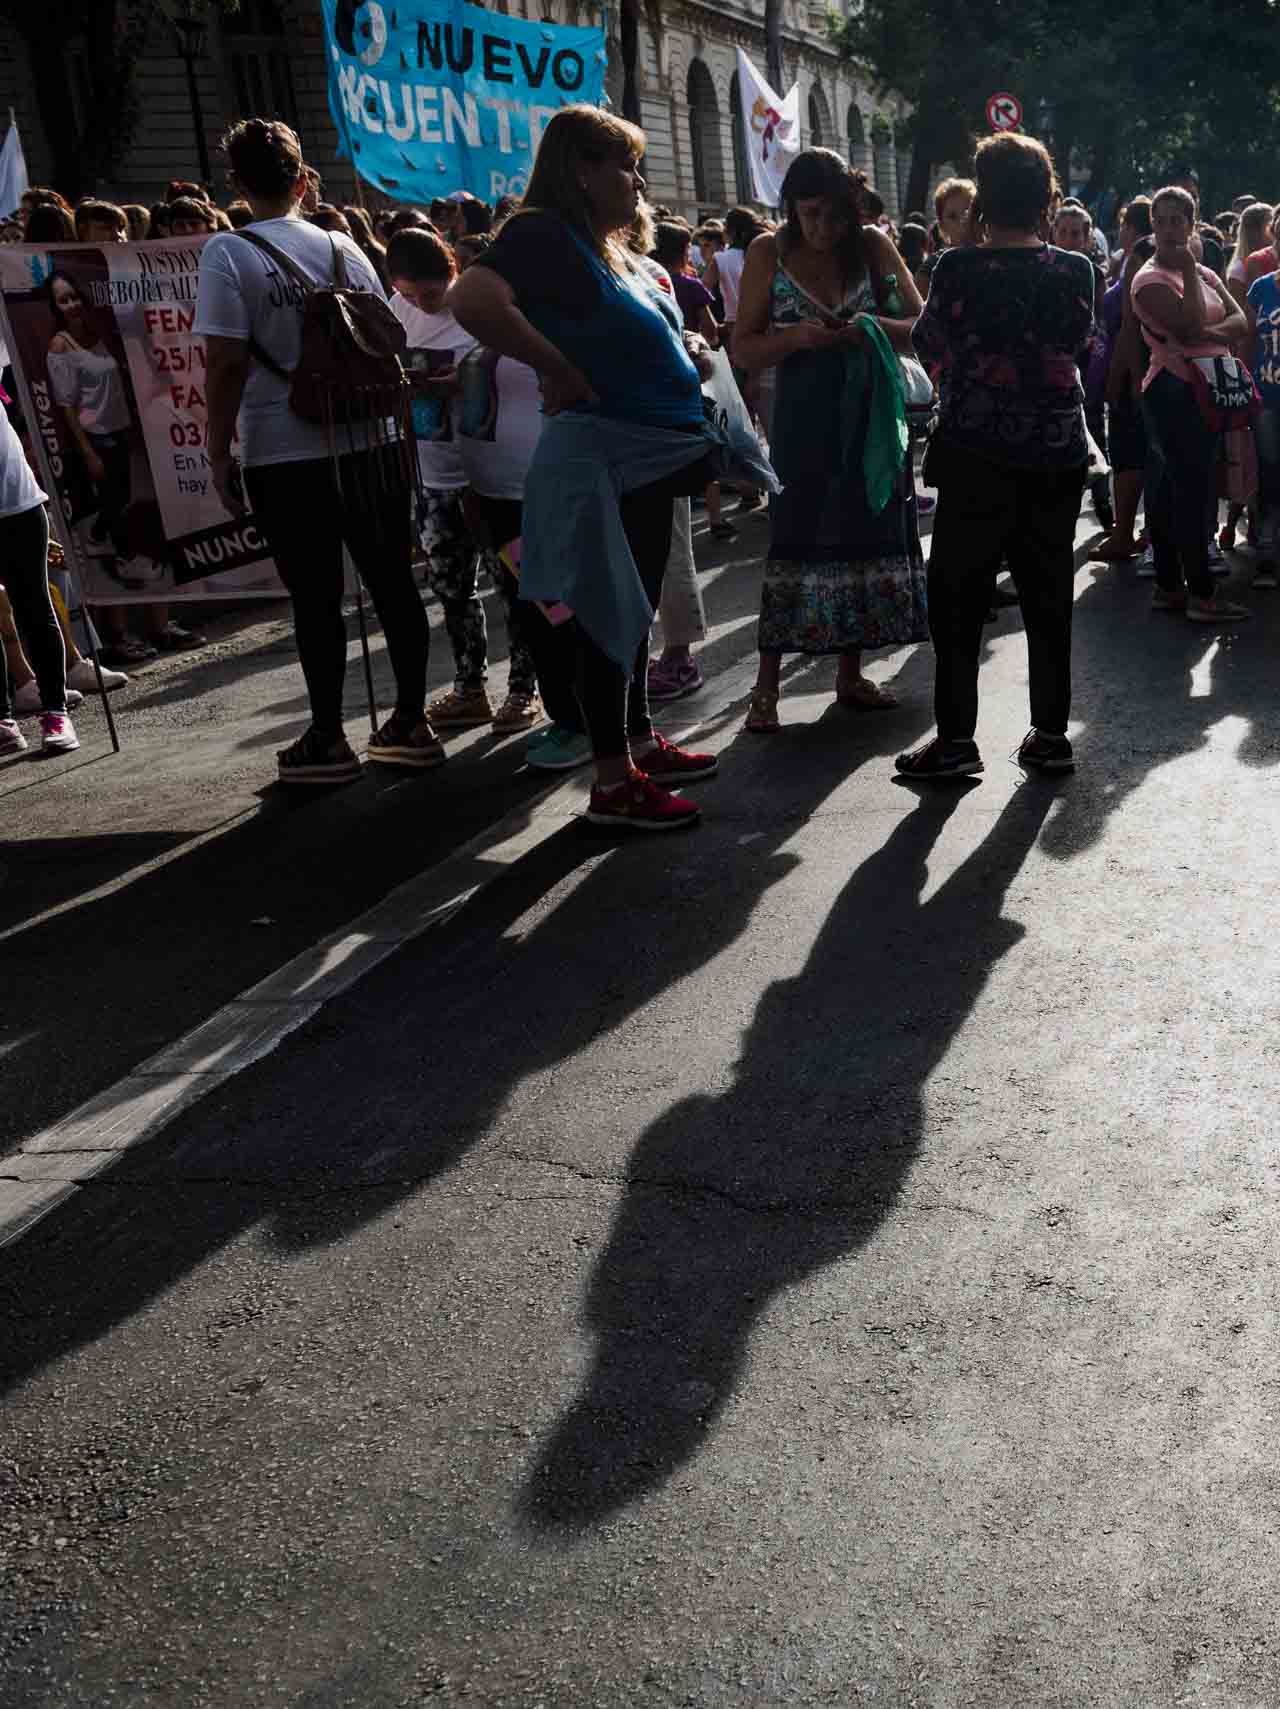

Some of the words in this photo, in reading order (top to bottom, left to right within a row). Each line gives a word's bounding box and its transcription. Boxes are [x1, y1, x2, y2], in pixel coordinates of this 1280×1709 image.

[416, 21, 585, 91] NUEVO
[153, 345, 208, 372] 25/1
[170, 384, 206, 409] FA
[170, 422, 209, 447] 03/
[174, 454, 195, 471] En
[177, 476, 208, 496] hay
